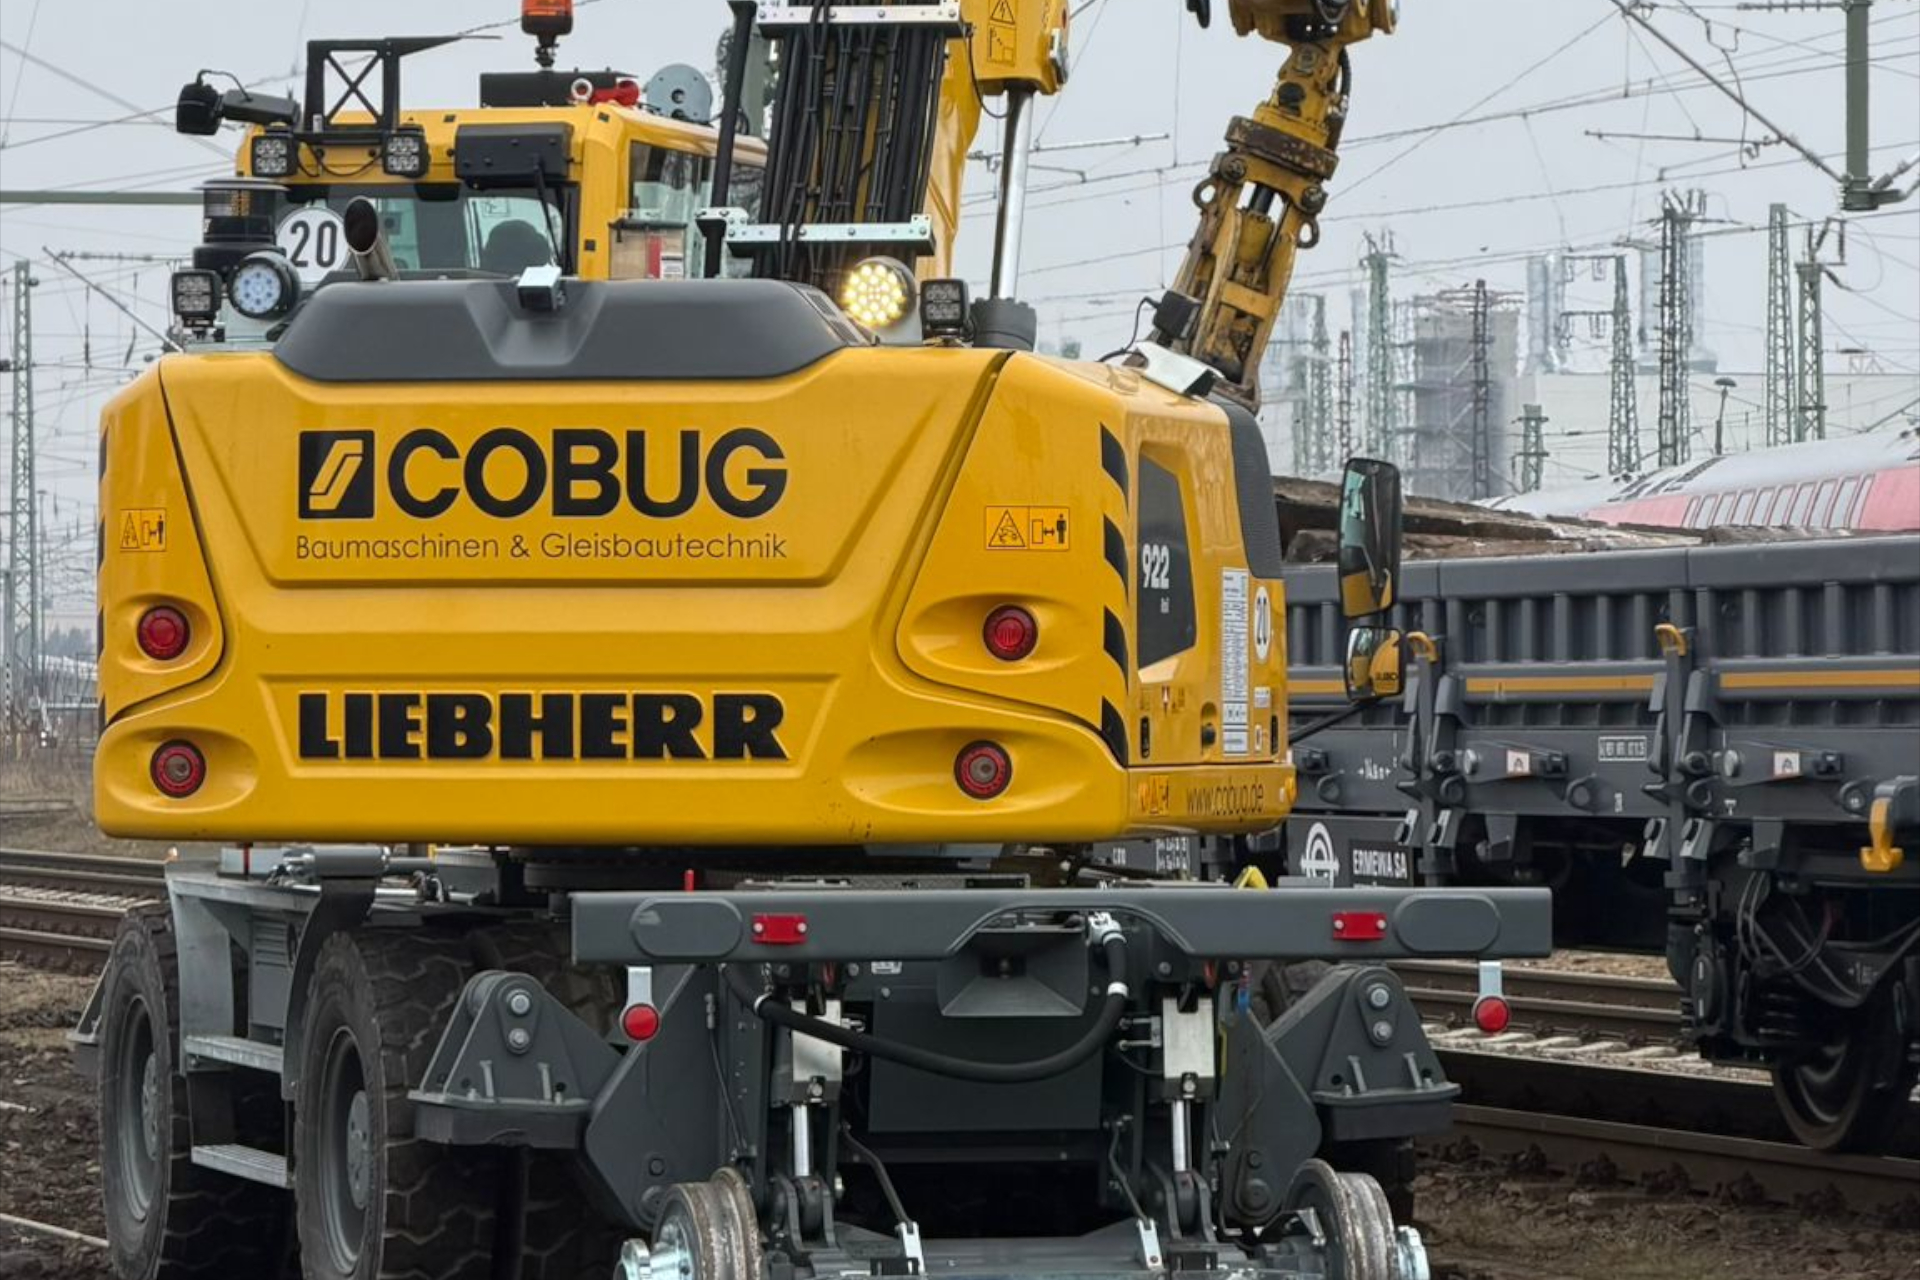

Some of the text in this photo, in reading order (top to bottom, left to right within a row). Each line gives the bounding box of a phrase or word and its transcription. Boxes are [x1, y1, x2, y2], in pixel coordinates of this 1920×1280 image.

[290, 220, 337, 268] 20
[387, 427, 788, 519] COBUG
[296, 532, 788, 559] Baumaschinen & Gleisbautechnik
[1142, 543, 1170, 589] 922
[299, 692, 790, 760] LIEBHERR
